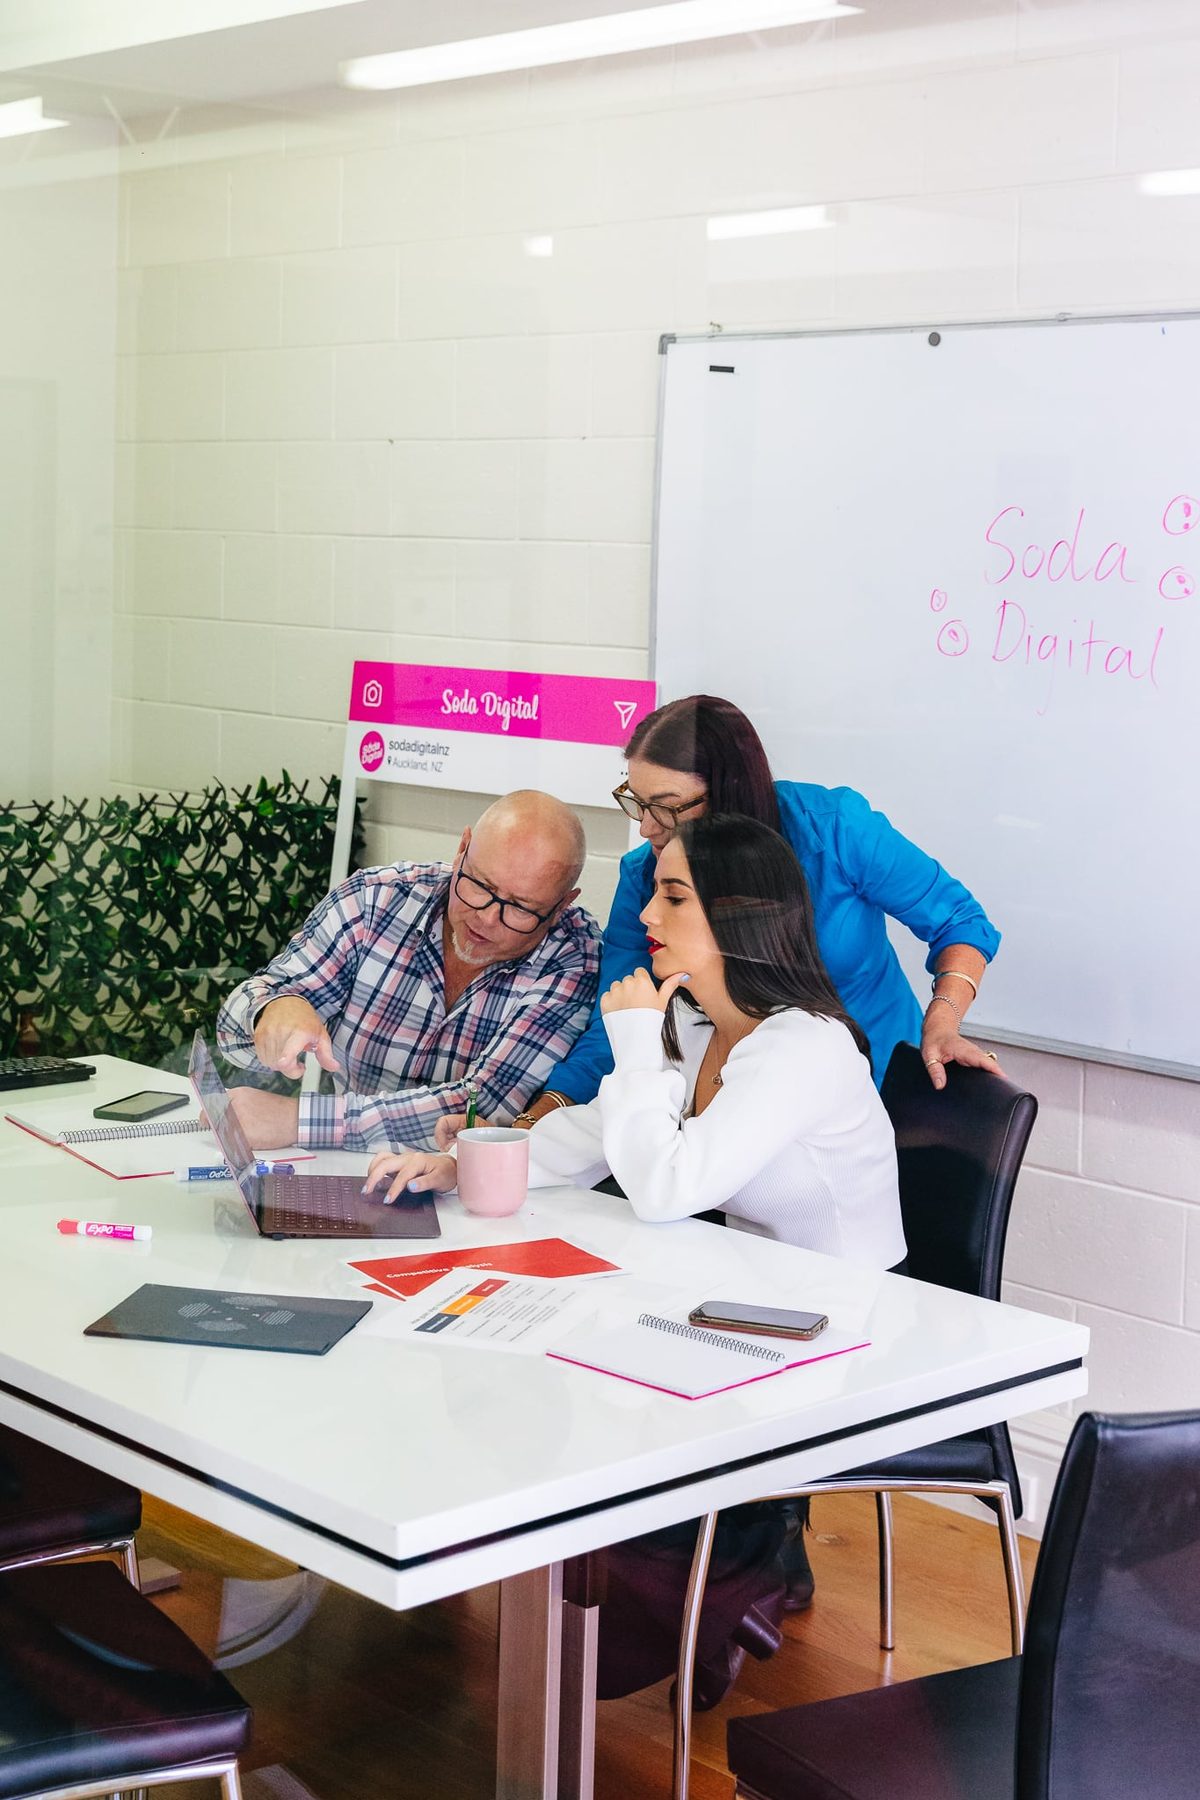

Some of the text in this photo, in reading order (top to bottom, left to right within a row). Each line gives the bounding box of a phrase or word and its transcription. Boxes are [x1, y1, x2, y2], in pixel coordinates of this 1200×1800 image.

[984, 505, 1138, 585] Soda
[992, 600, 1164, 715] Digital
[441, 688, 539, 731] Soda Digital
[388, 739, 450, 756] sodadigitalnz
[431, 761, 443, 773] NZ
[87, 1224, 113, 1235] EXPO
[386, 1268, 450, 1279] Competitive
